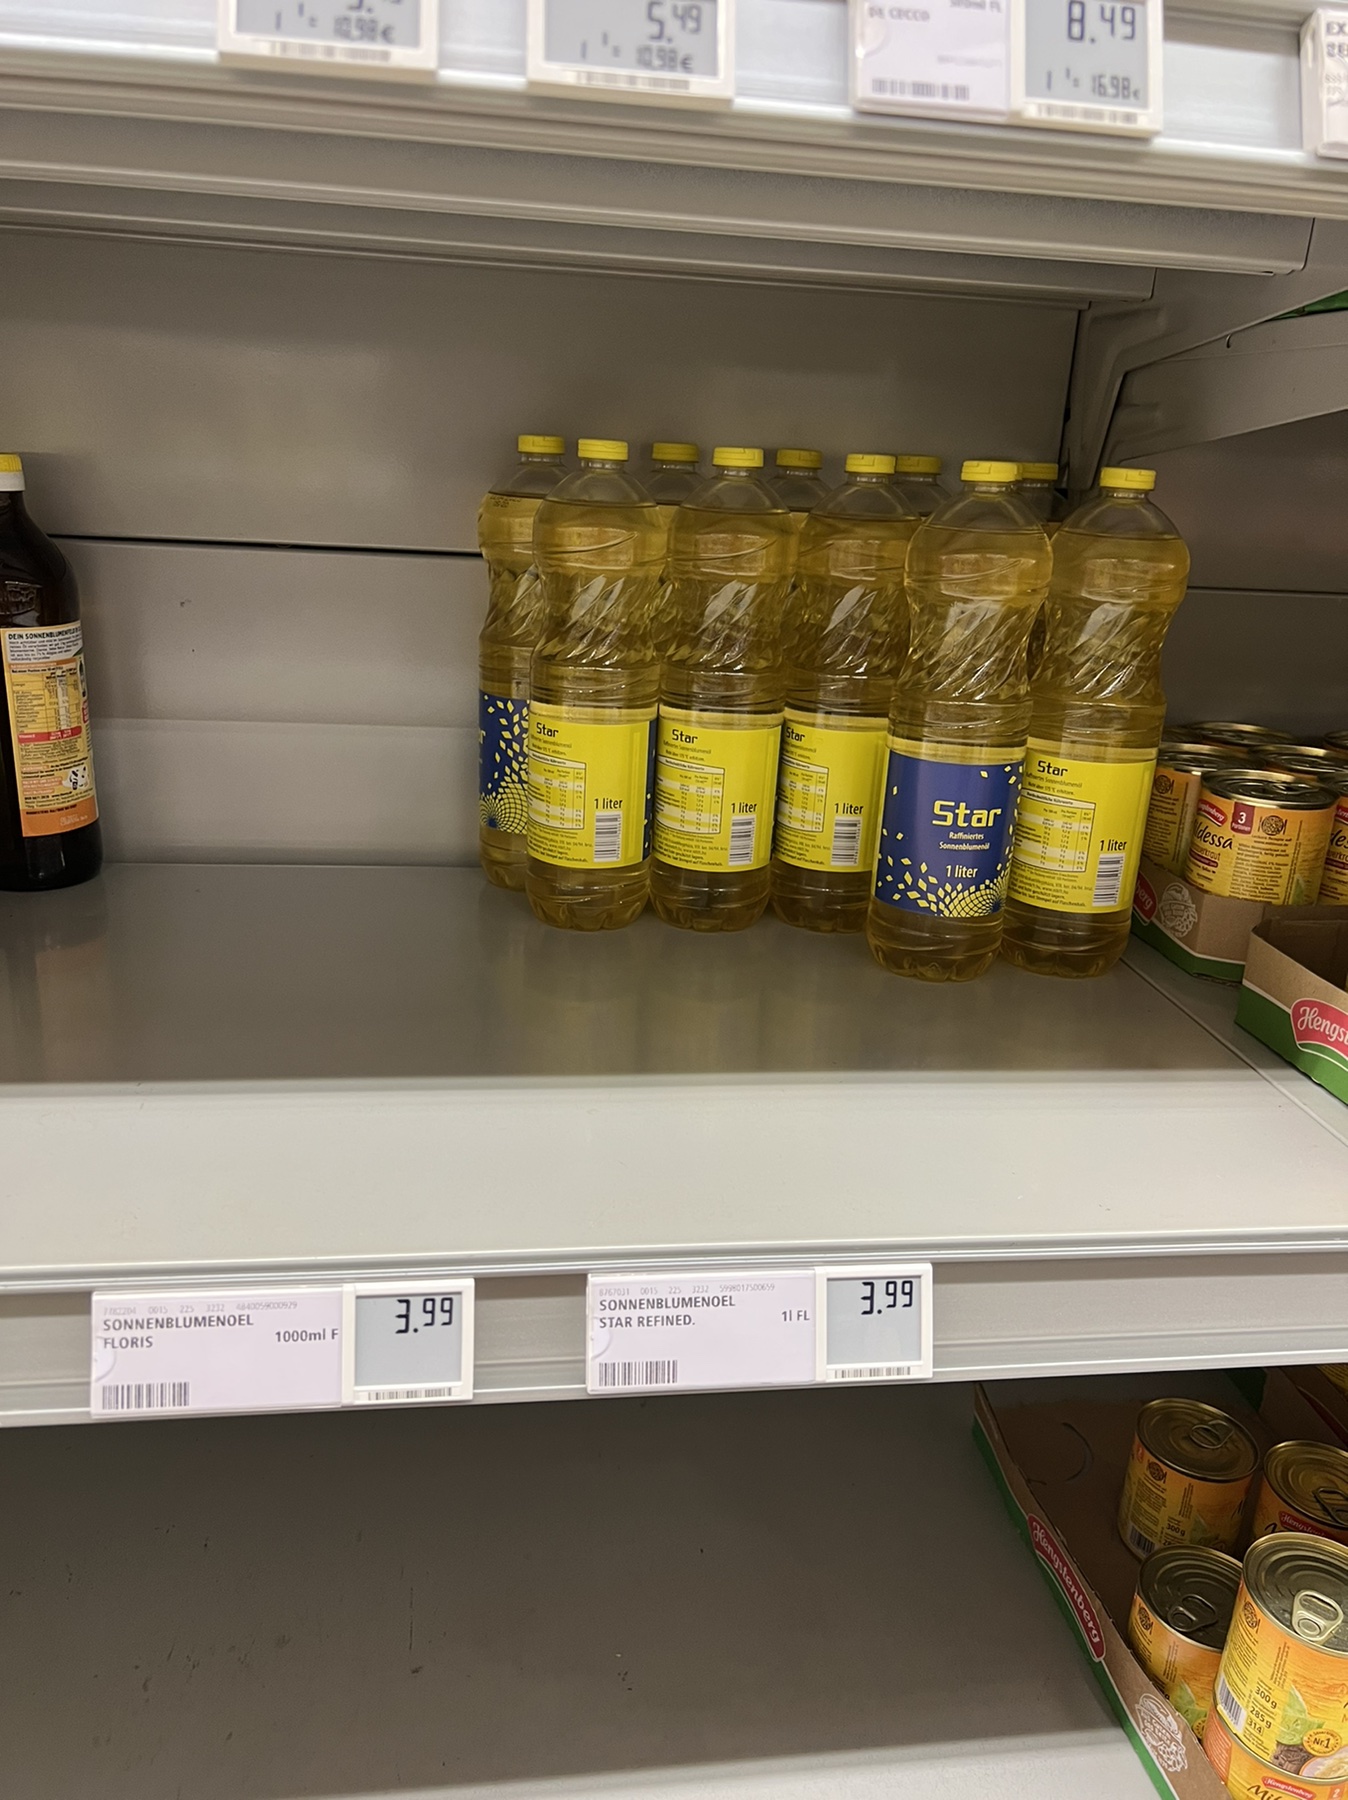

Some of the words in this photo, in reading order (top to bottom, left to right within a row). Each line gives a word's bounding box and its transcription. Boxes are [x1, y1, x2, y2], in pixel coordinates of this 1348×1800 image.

[647, 1, 703, 44] 5.49
[1067, 0, 1136, 44] 8.49
[536, 721, 559, 738] Star
[672, 728, 699, 744] Star
[786, 726, 806, 742] Star
[1036, 760, 1069, 777] Star
[594, 798, 600, 810] 1
[602, 797, 623, 810] liter
[731, 802, 736, 814] 1
[738, 801, 758, 813] liter
[834, 803, 840, 815] 1
[842, 802, 864, 815] liter
[931, 799, 1002, 829] Star
[1237, 811, 1247, 824] 3
[938, 841, 991, 851] Sonnenblumenöl
[1099, 839, 1105, 852] 1
[1107, 839, 1128, 852] liter
[945, 864, 952, 878] 1
[954, 864, 978, 879] liter
[640, 1287, 658, 1296] 0015
[669, 1286, 682, 1295] 225
[692, 1285, 709, 1294] 3232
[860, 1279, 914, 1316] 3.99
[599, 1295, 736, 1312] SONNENBLUMENOEL
[103, 1313, 255, 1332] SONNENBLUMENOEL
[395, 1296, 454, 1335] 3.99
[599, 1316, 633, 1329] STAR
[637, 1314, 696, 1328] REFINED.
[797, 1309, 810, 1322] FL
[103, 1335, 154, 1350] FLORIS
[274, 1328, 327, 1344] 1000ml
[331, 1327, 339, 1341] F
[1032, 1520, 1101, 1644] Hengstenberg
[1254, 1685, 1271, 1704] 300
[1249, 1705, 1265, 1723] 285
